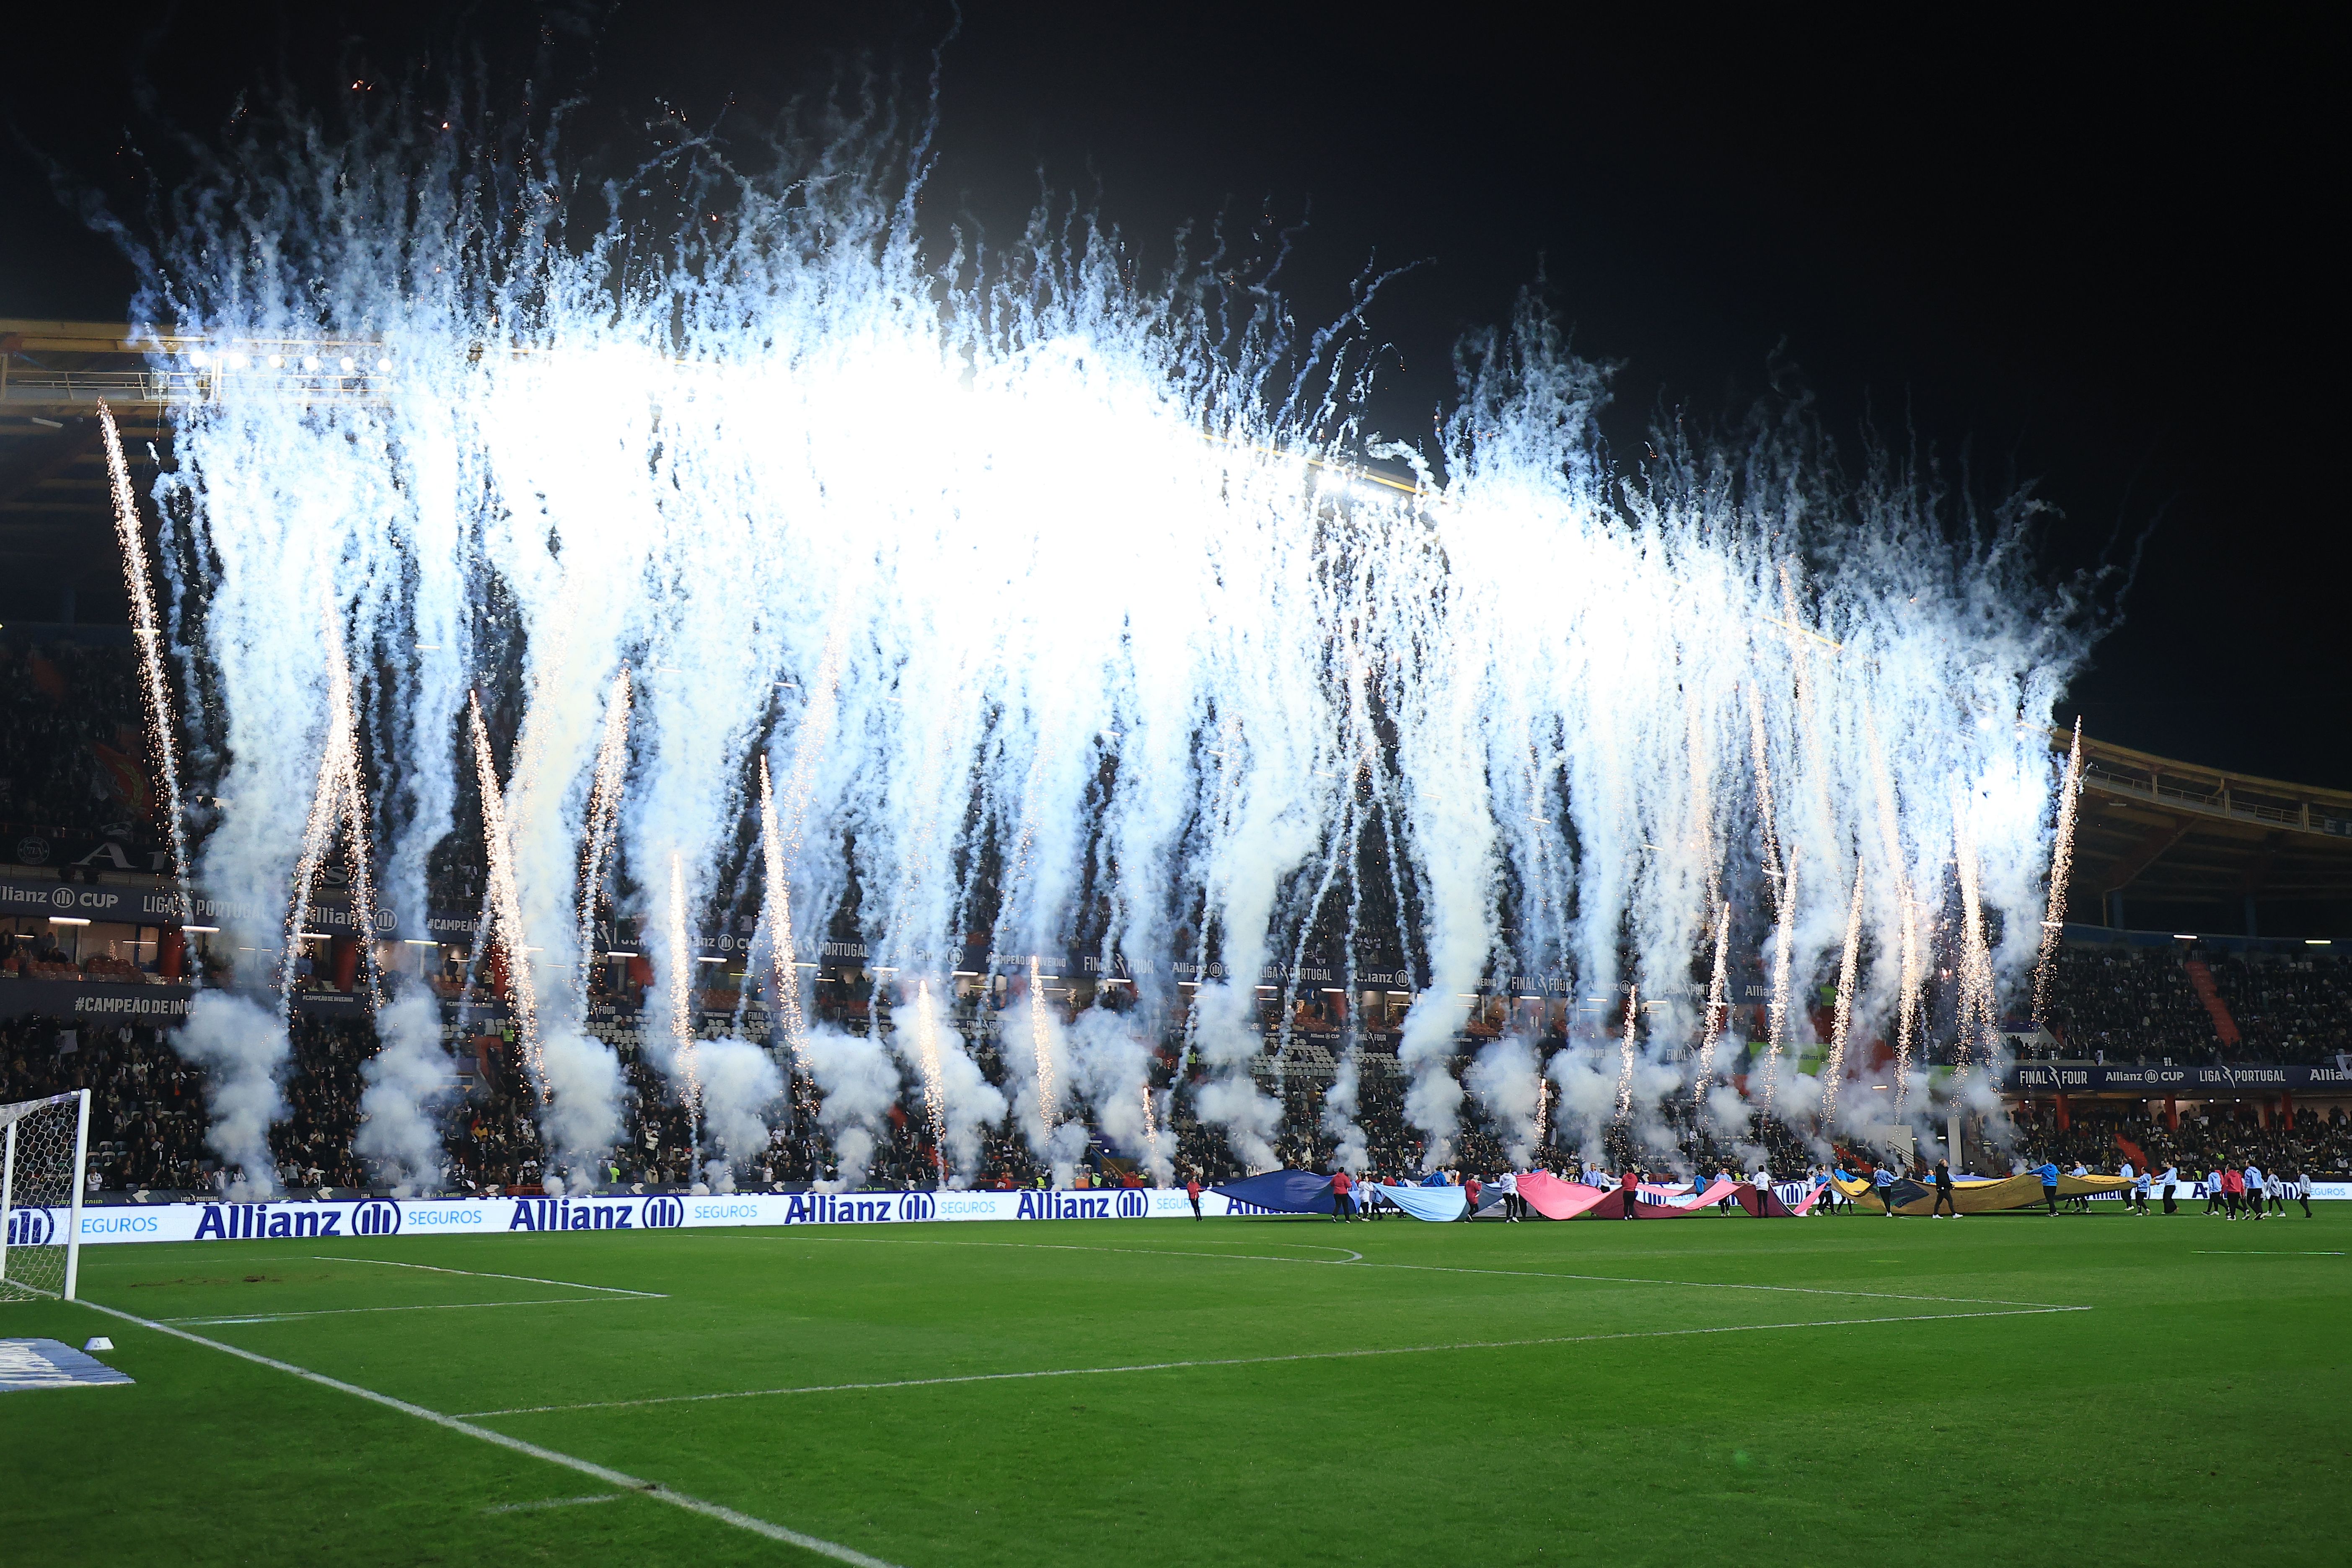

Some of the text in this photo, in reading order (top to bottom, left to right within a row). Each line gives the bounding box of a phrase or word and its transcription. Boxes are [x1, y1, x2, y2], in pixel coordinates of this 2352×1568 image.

[79, 892, 119, 908] CUP
[818, 942, 869, 957] PORTUGAL
[1260, 966, 1278, 978] LIGA
[1511, 977, 1536, 990] FINAL
[75, 997, 150, 1013] #CAMPEÃO
[151, 1000, 168, 1014] DE
[748, 1012, 765, 1020] FINAL
[1666, 1049, 1688, 1060] FINAL
[2020, 1071, 2087, 1084] FINAL FOUR
[2106, 1071, 2184, 1081] Allianz CUP
[2200, 1070, 2286, 1082] LIGA PORTUGAL
[2311, 1188, 2345, 1196] EGUROS
[784, 1195, 996, 1224] Allianz SEGUROS
[1017, 1192, 1109, 1219] Allianz
[194, 1204, 482, 1239] Allianz SEGUROS
[509, 1199, 758, 1231] Allianz SEGUROS
[81, 1217, 158, 1233] EGUROS
